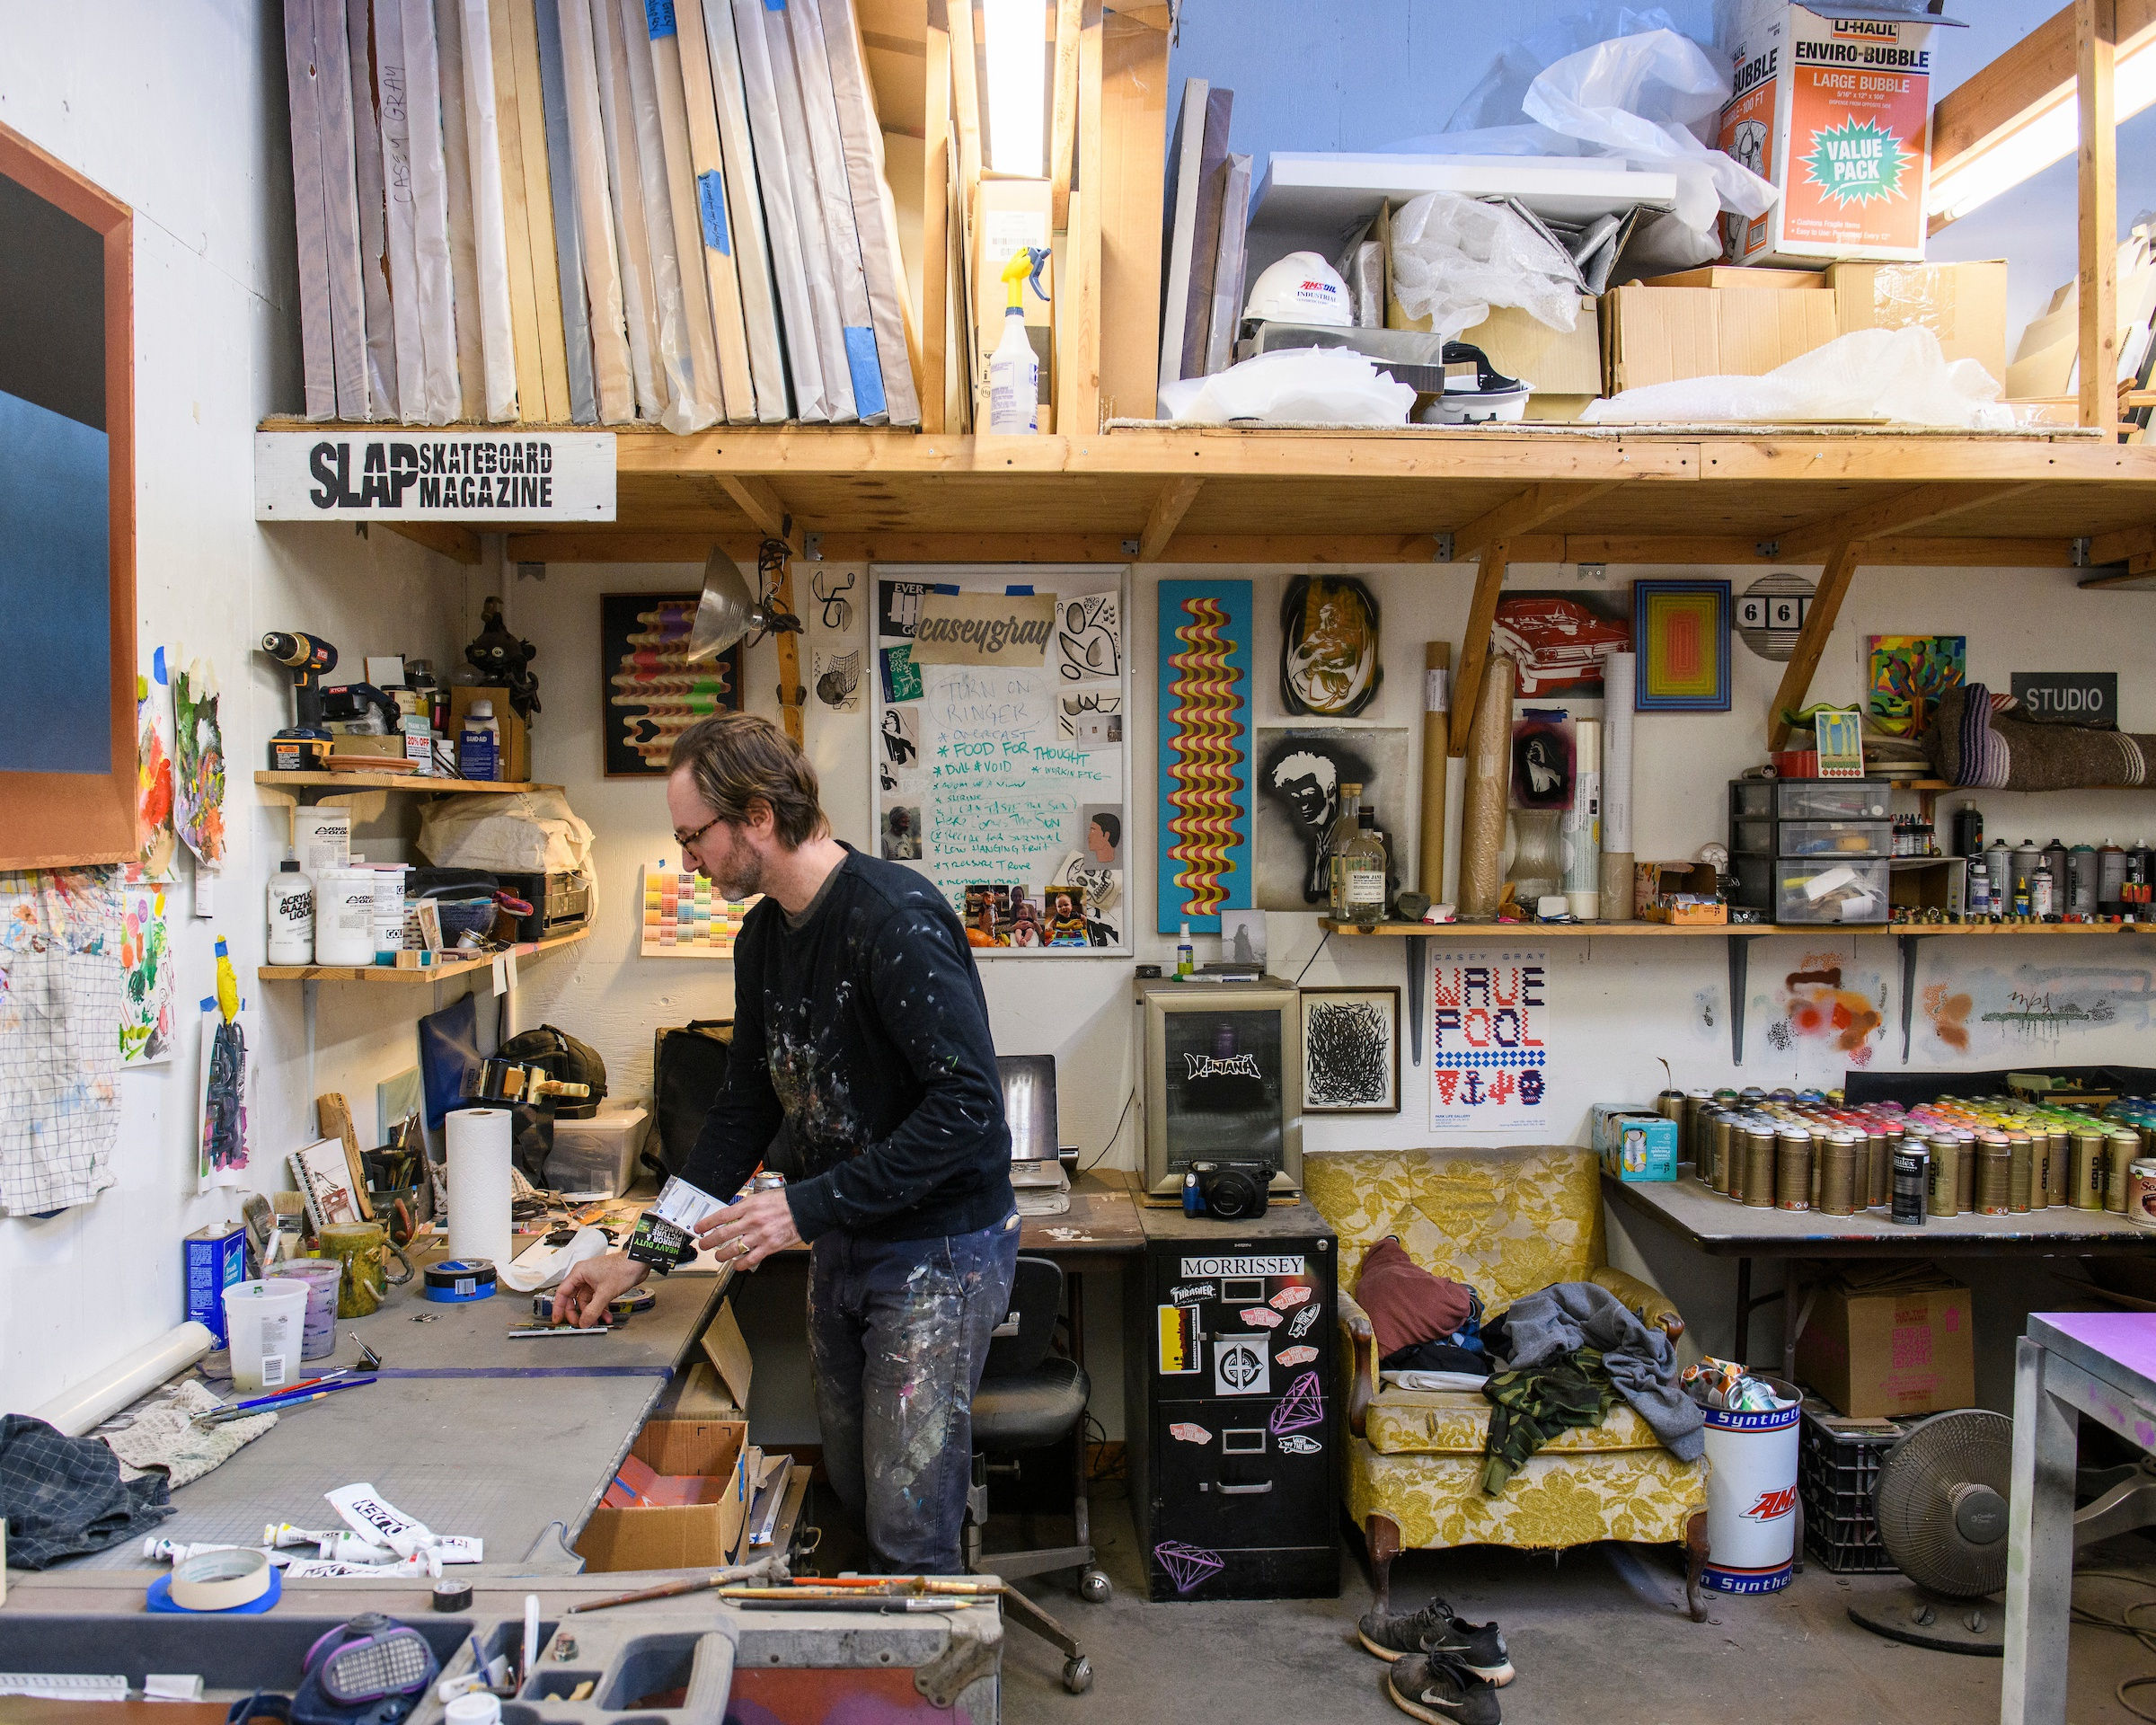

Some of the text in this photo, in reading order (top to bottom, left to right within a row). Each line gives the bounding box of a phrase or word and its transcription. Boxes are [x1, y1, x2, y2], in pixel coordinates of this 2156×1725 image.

[1796, 41, 1929, 68] ENVIRO-BUBBLE
[1813, 72, 1910, 93] LARGE BUBBLE
[384, 66, 414, 203] CASEY GRAY
[1826, 138, 1883, 161] VALUE
[1833, 159, 1880, 181] PACK
[1297, 291, 1336, 303] INDUSTRIAL
[1300, 281, 1336, 293] AMSOIL
[420, 442, 552, 474] SKATEBOARD
[310, 441, 419, 509] SLAP
[420, 476, 552, 509] MAGAZINE
[895, 583, 924, 595] EVER
[1745, 604, 1790, 621] 6 6
[918, 615, 1056, 655] caseygray
[941, 679, 1030, 702] TURN ON
[2026, 687, 2103, 712] STUDIO
[947, 703, 1029, 725] RINGER
[408, 736, 429, 748] 20% OFF
[953, 741, 1091, 766] FOOD FOR THOUGHT
[984, 761, 1012, 773] VOID
[972, 845, 1020, 854] HANGING
[1435, 967, 1545, 1006] WAVE
[1435, 1008, 1544, 1048] POOL
[1183, 1052, 1261, 1080] MONTANA
[2091, 1156, 2099, 1190] GOLD
[634, 1238, 680, 1255] HEAVY DUTY
[652, 1228, 684, 1243] PICTURE
[652, 1235, 682, 1248] MIRROR
[1184, 1258, 1303, 1275] MORRISSEY
[1171, 1284, 1215, 1303] THRASHER
[1718, 1406, 1800, 1428] Syntheti
